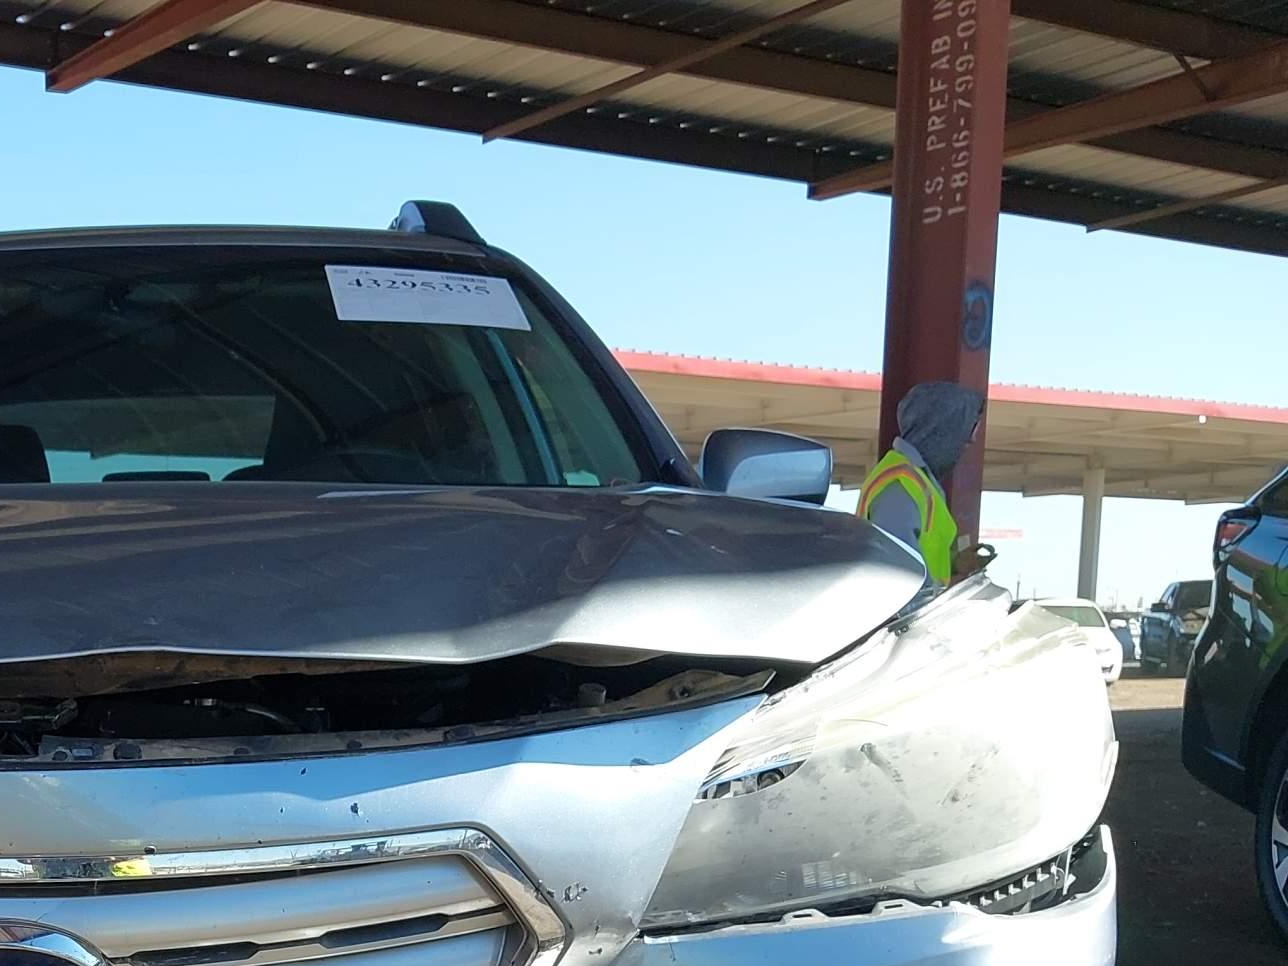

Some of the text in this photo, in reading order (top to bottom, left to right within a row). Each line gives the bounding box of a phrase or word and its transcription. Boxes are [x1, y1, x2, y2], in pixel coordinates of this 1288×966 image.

[926, 35, 951, 151] PREFAB
[922, 166, 944, 224] U.S.
[347, 276, 491, 295] 43295335
